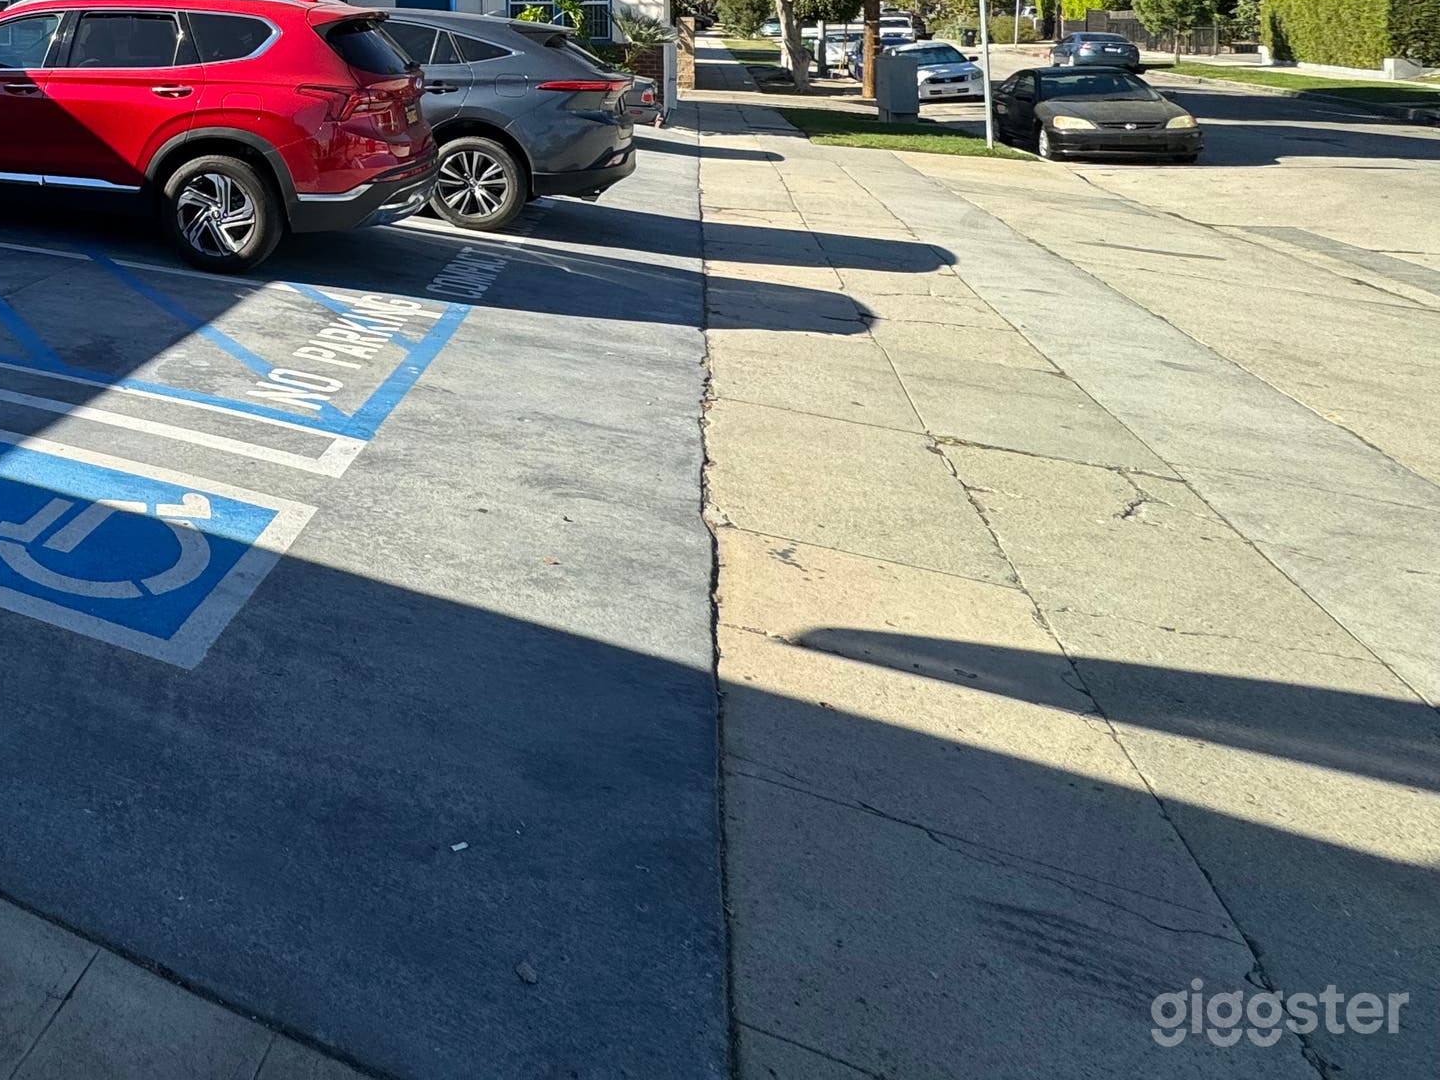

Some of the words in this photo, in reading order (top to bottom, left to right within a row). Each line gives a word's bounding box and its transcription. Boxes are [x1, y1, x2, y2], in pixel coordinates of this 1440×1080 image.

[426, 246, 511, 299] COMPACT
[292, 294, 424, 369] PARKING
[246, 368, 344, 411] NO
